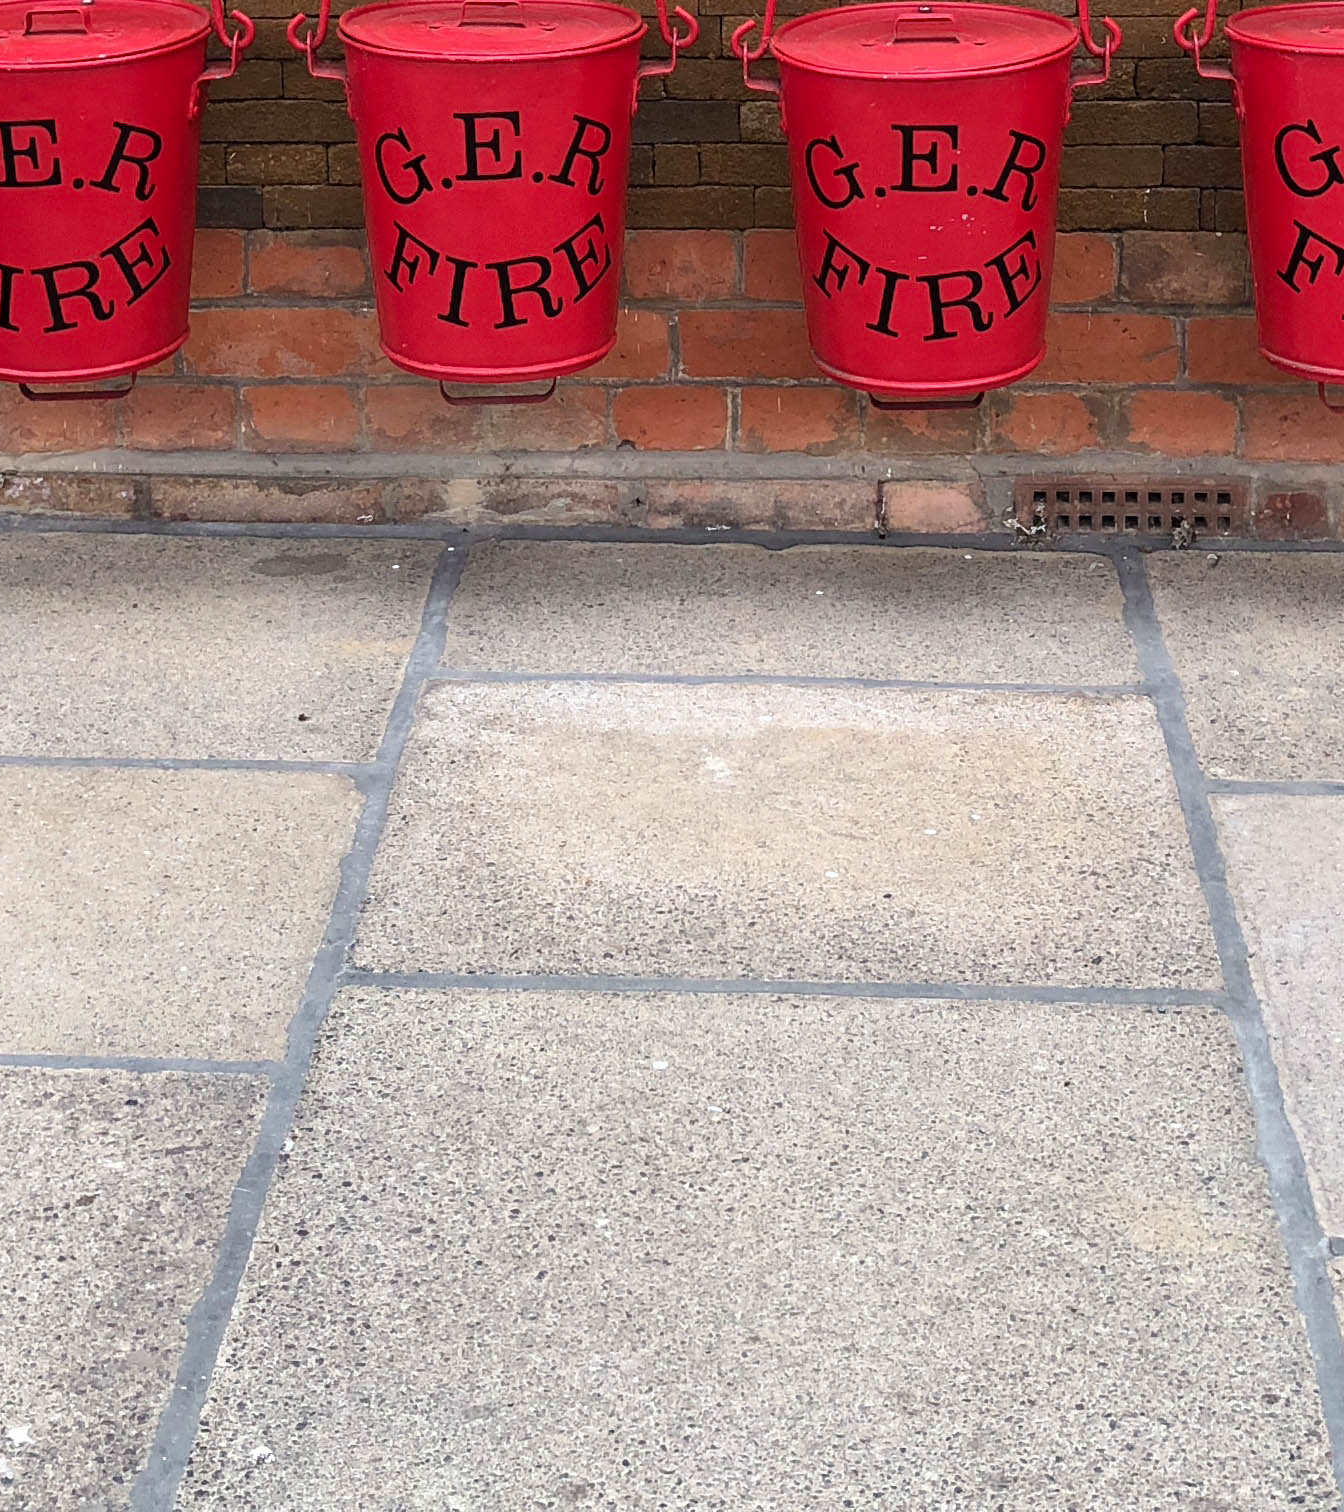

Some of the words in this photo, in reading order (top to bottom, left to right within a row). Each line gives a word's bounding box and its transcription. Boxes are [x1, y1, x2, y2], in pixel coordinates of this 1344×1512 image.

[376, 112, 611, 204] G.E.R
[806, 125, 1045, 211] G.E.R
[384, 214, 611, 328] FIRE
[813, 230, 1041, 341] FIRE
